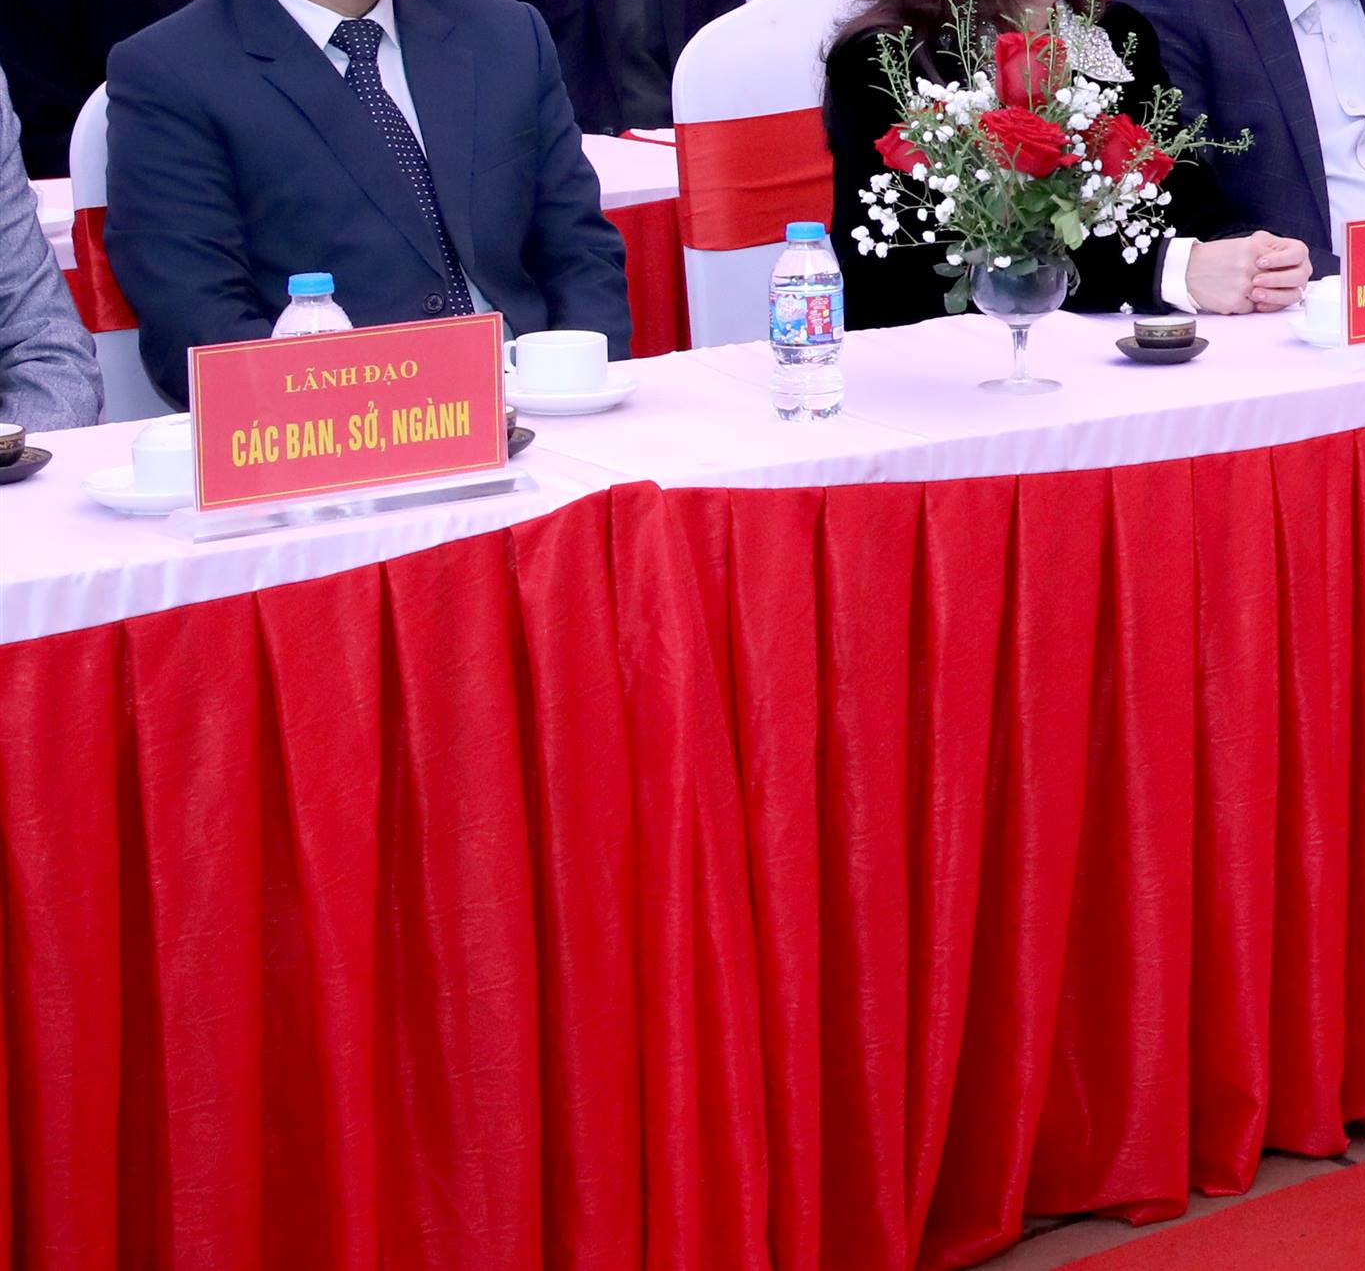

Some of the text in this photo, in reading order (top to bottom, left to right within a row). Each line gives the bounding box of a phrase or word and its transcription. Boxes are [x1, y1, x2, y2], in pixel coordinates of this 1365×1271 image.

[285, 360, 418, 393] LÃNH ĐẠO
[231, 398, 470, 467] CÁC BAN, SỞ, NGÀNH
